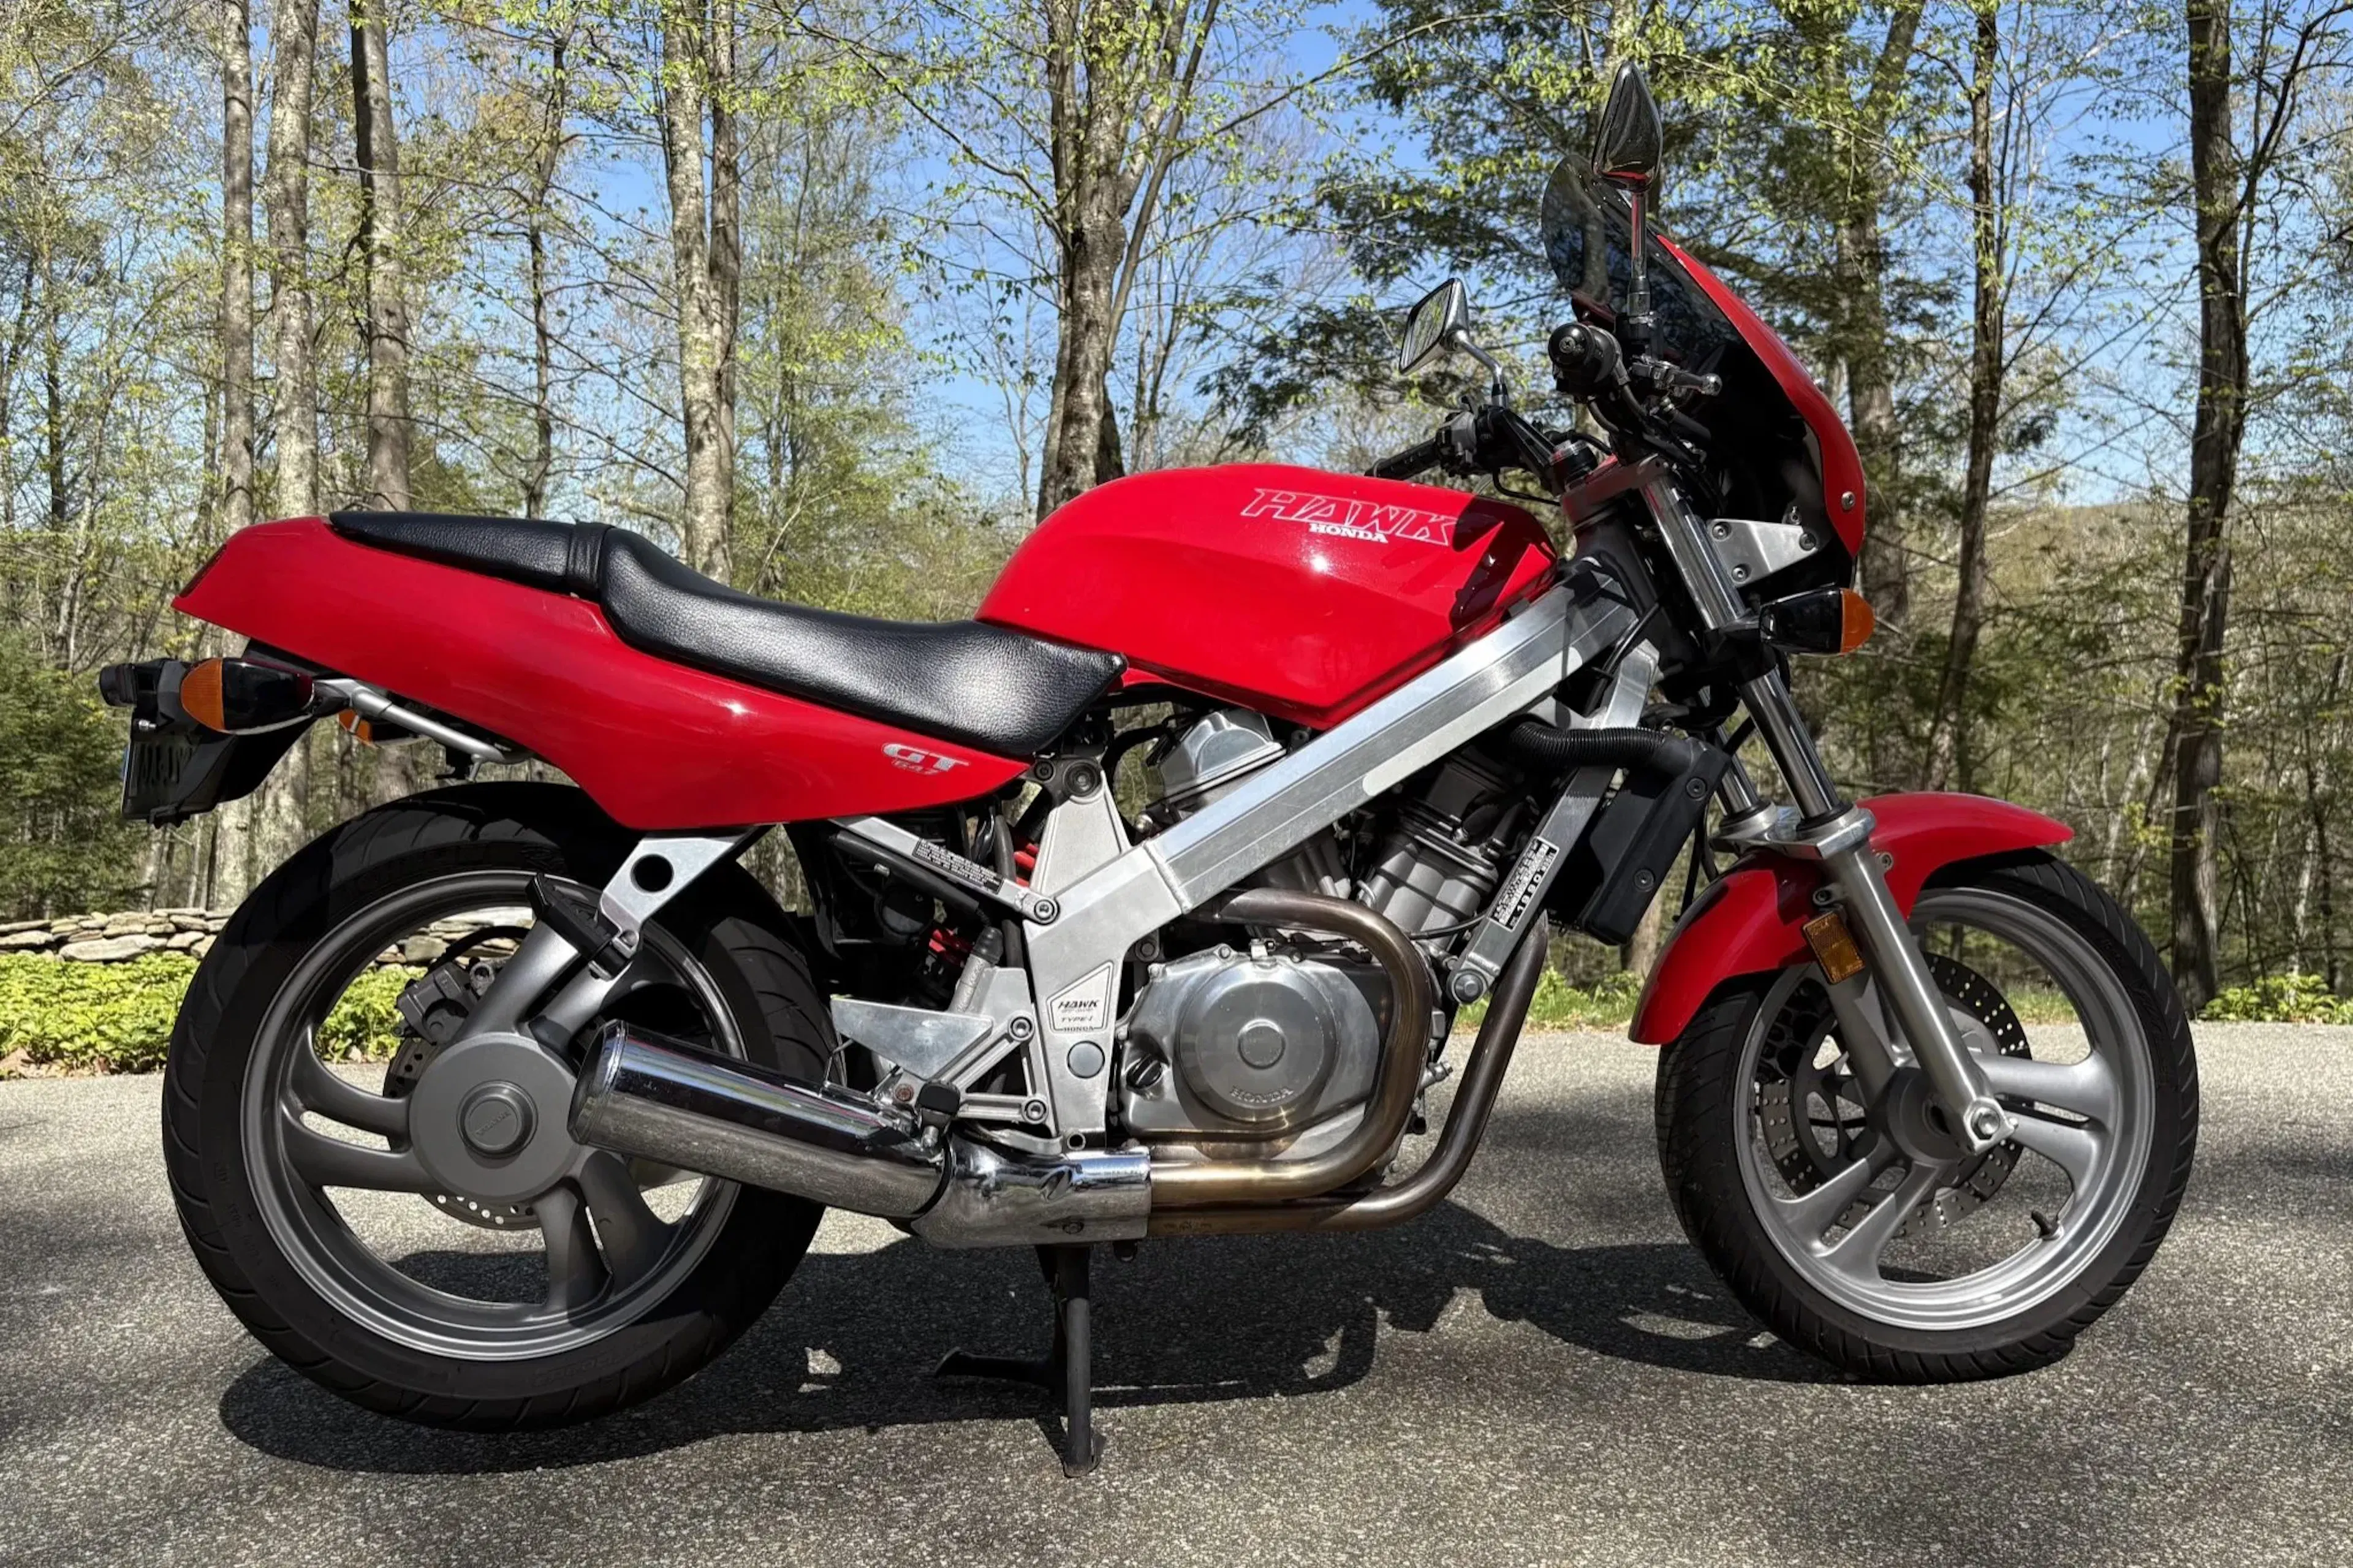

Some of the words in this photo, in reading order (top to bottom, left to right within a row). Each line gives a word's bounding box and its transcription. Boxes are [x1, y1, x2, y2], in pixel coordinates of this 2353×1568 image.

[1240, 488, 1458, 546] HAWK
[1310, 523, 1388, 543] HONDA
[882, 743, 969, 771] GT
[1058, 1000, 1099, 1009] HAWK
[1230, 1085, 1294, 1104] HONDA
